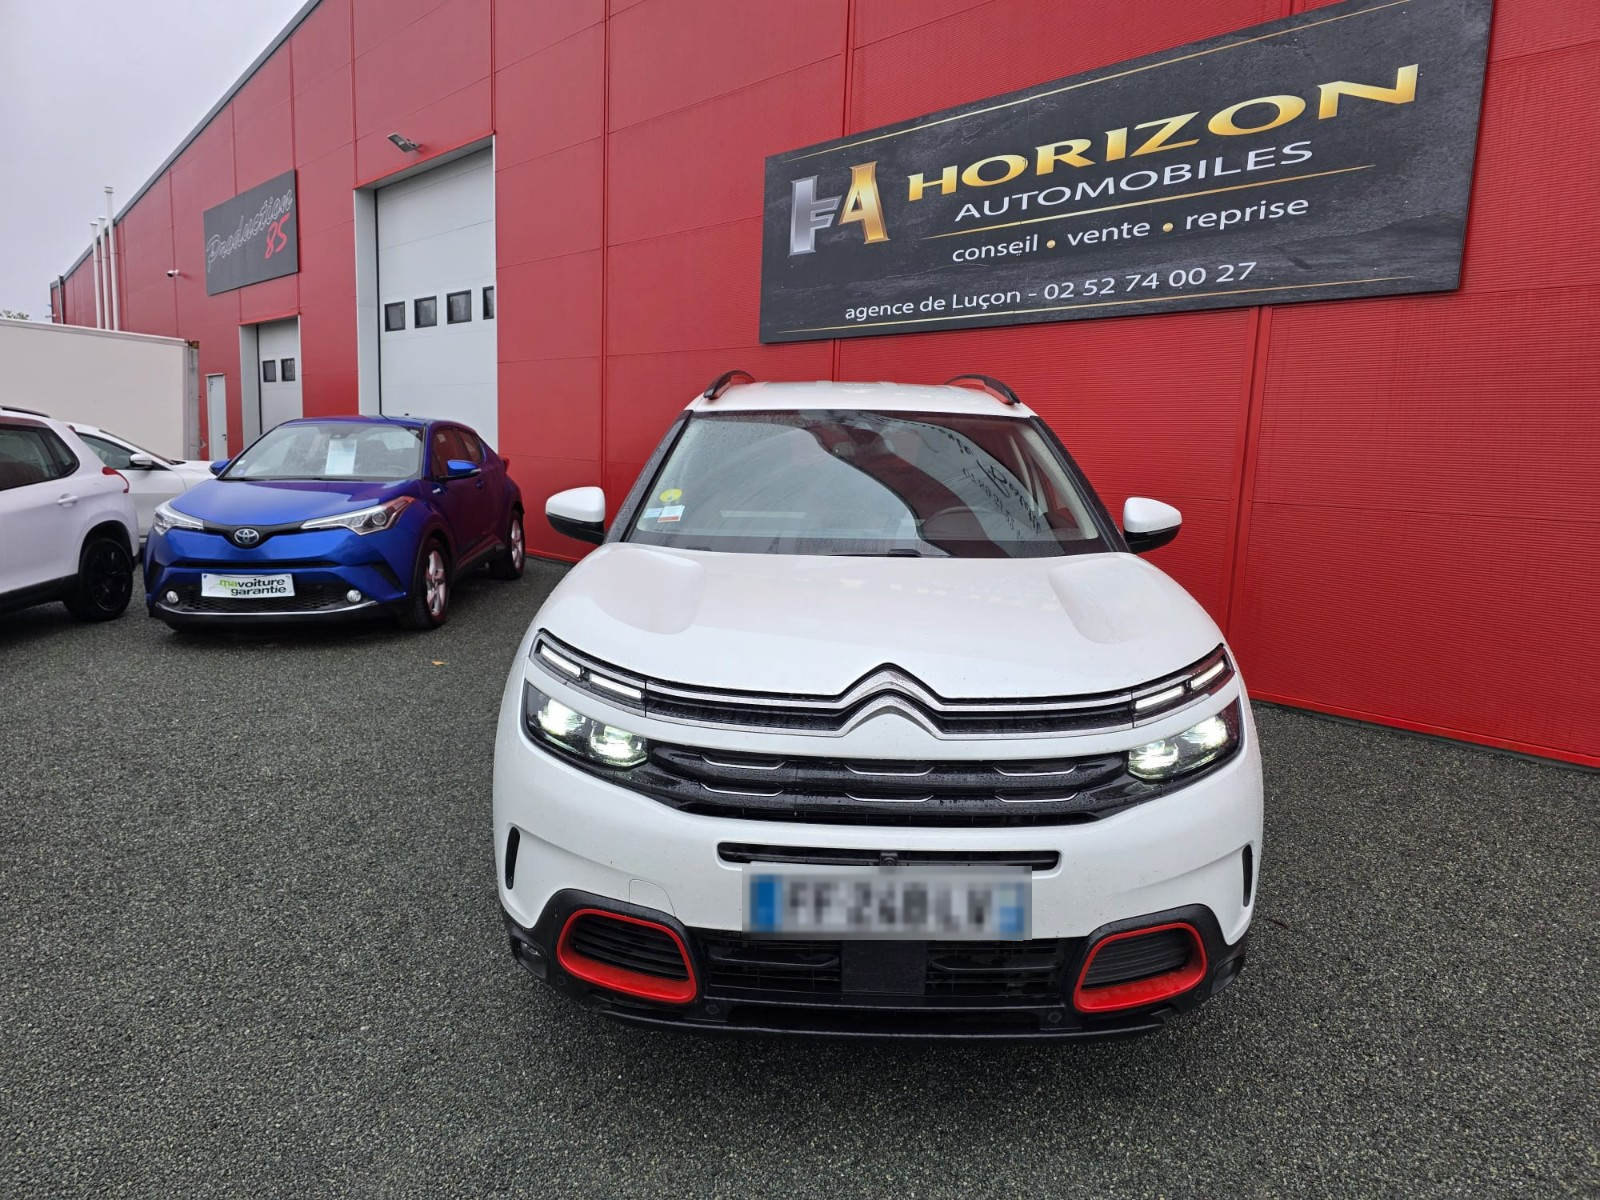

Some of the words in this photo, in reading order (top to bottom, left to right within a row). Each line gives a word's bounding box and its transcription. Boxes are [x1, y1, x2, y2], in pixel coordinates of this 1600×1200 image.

[908, 63, 1418, 203] HORIZON
[954, 140, 1313, 222] AUTOMOBILES
[264, 212, 291, 259] 85
[952, 233, 1038, 262] conseil
[1067, 221, 1151, 247] vente
[1185, 199, 1309, 231] reprise
[845, 300, 915, 322] agence
[919, 296, 946, 312] de
[952, 290, 1021, 311] Luçon
[1044, 281, 1075, 300] 02
[1082, 277, 1116, 297] 52
[1125, 272, 1160, 292] 74
[1168, 267, 1207, 287] 00
[1215, 261, 1257, 283] 27
[219, 578, 286, 588] mavoiture
[230, 585, 287, 597] garantie
